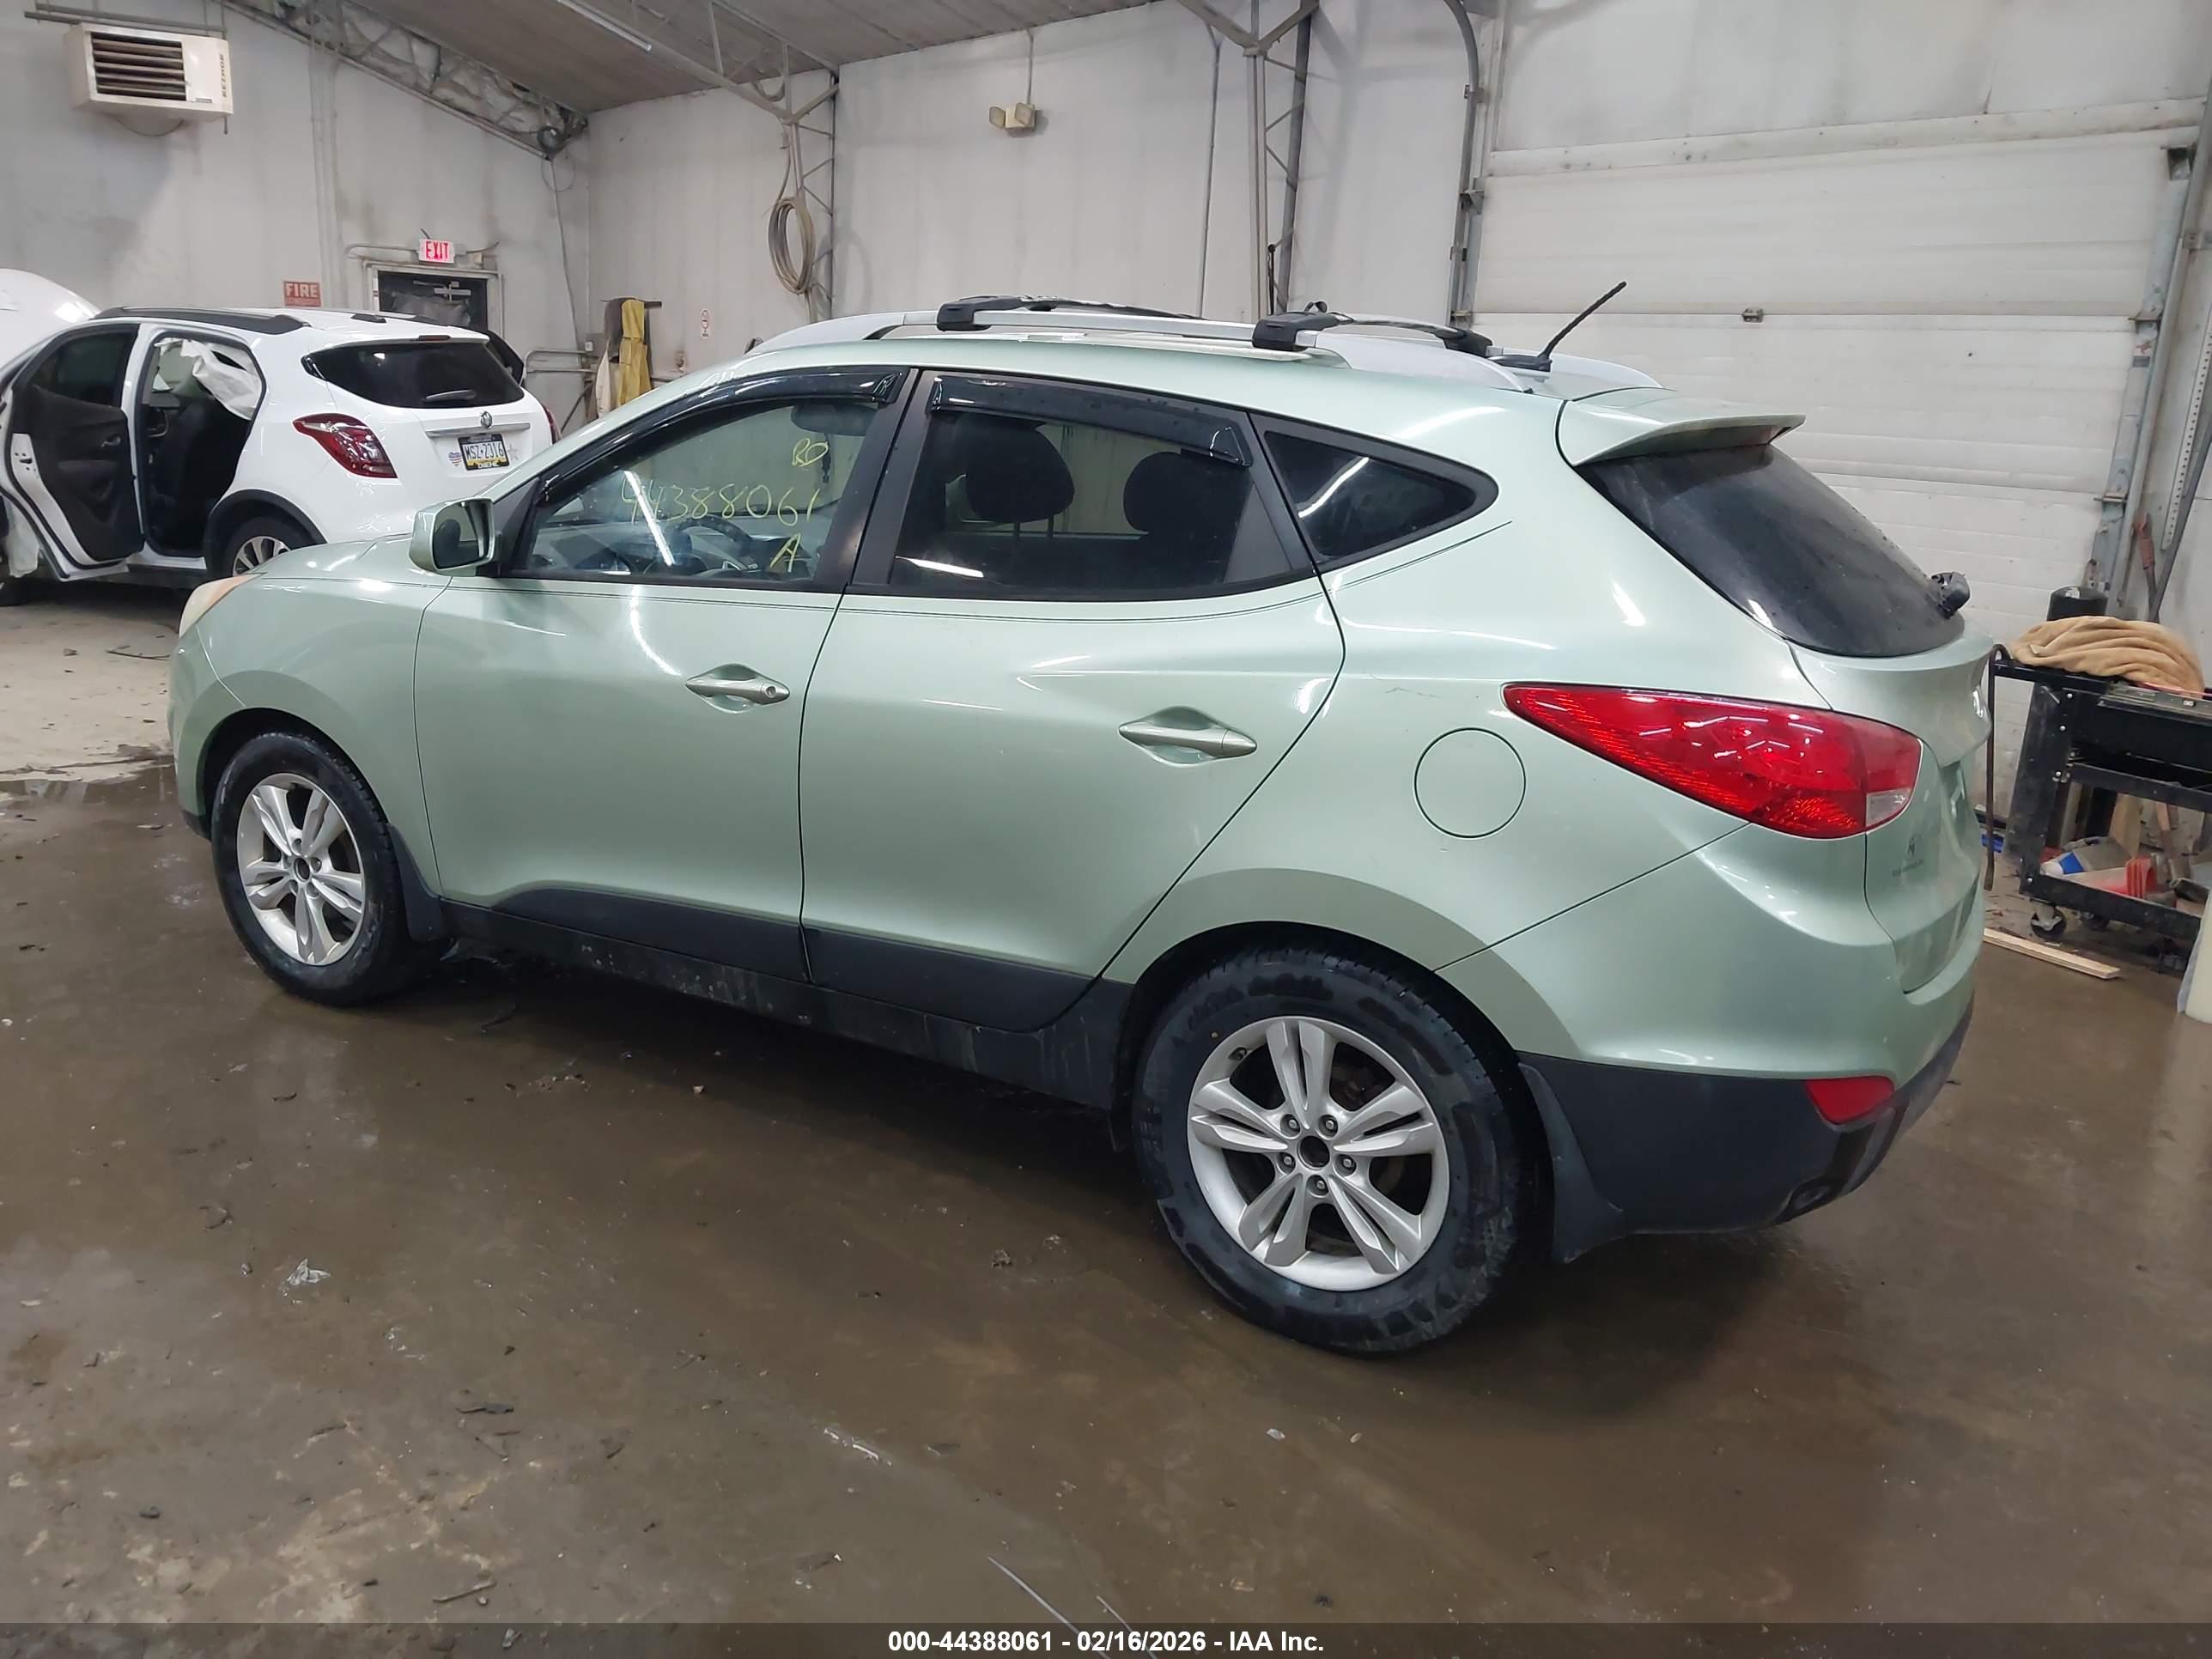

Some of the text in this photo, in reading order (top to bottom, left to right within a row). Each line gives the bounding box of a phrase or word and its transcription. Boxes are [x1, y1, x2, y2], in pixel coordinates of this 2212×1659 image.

[425, 240, 449, 259] EXIT
[285, 283, 319, 298] FIRE
[621, 479, 821, 527] 44388061
[769, 532, 800, 573] A
